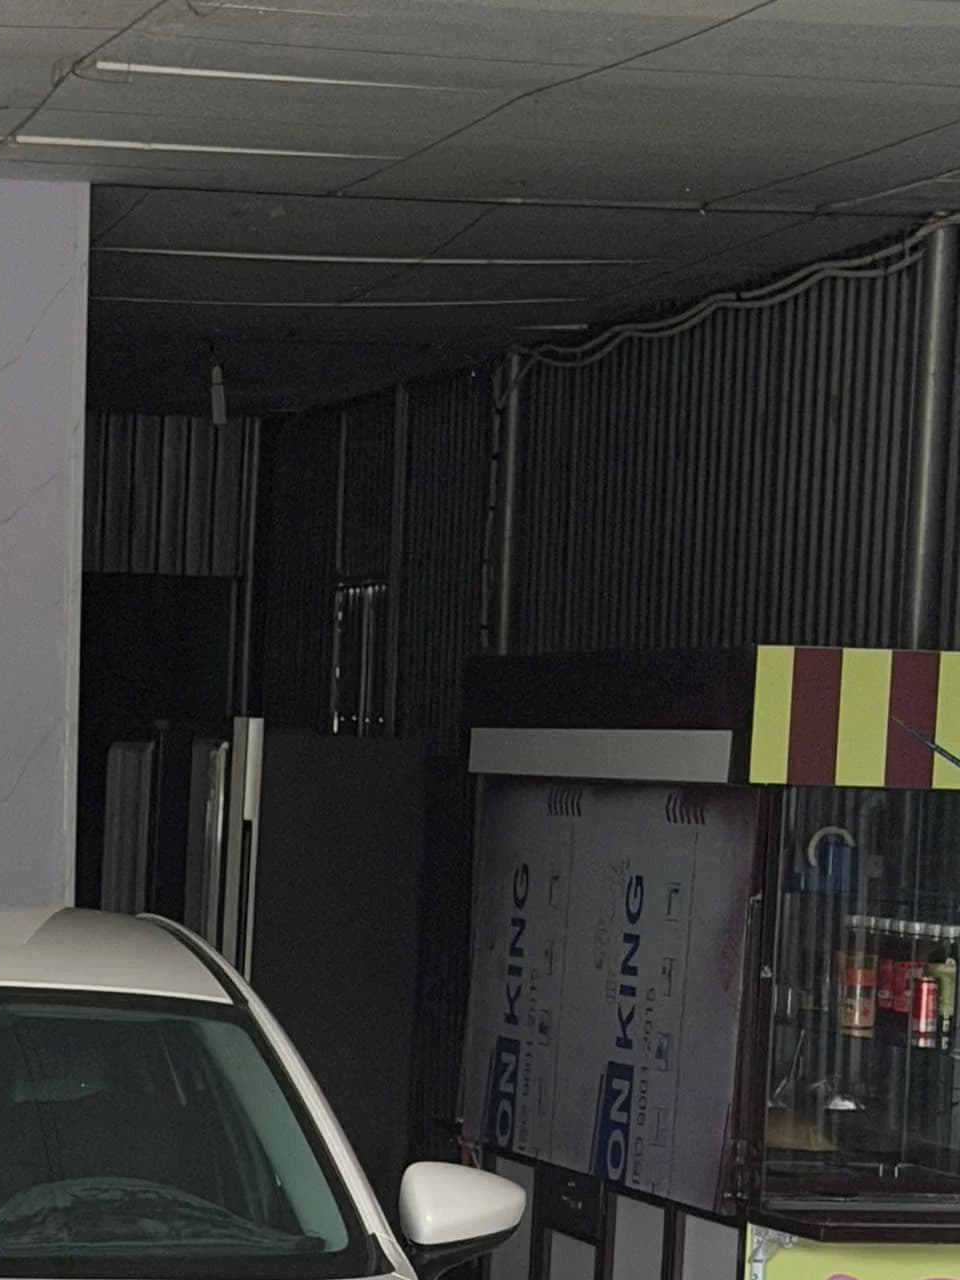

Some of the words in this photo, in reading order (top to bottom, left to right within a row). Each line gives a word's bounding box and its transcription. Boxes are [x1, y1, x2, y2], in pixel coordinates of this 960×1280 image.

[503, 863, 529, 1026] KING
[615, 874, 644, 1051] KING
[496, 1051, 517, 1148] ON
[607, 1077, 631, 1180] ON
